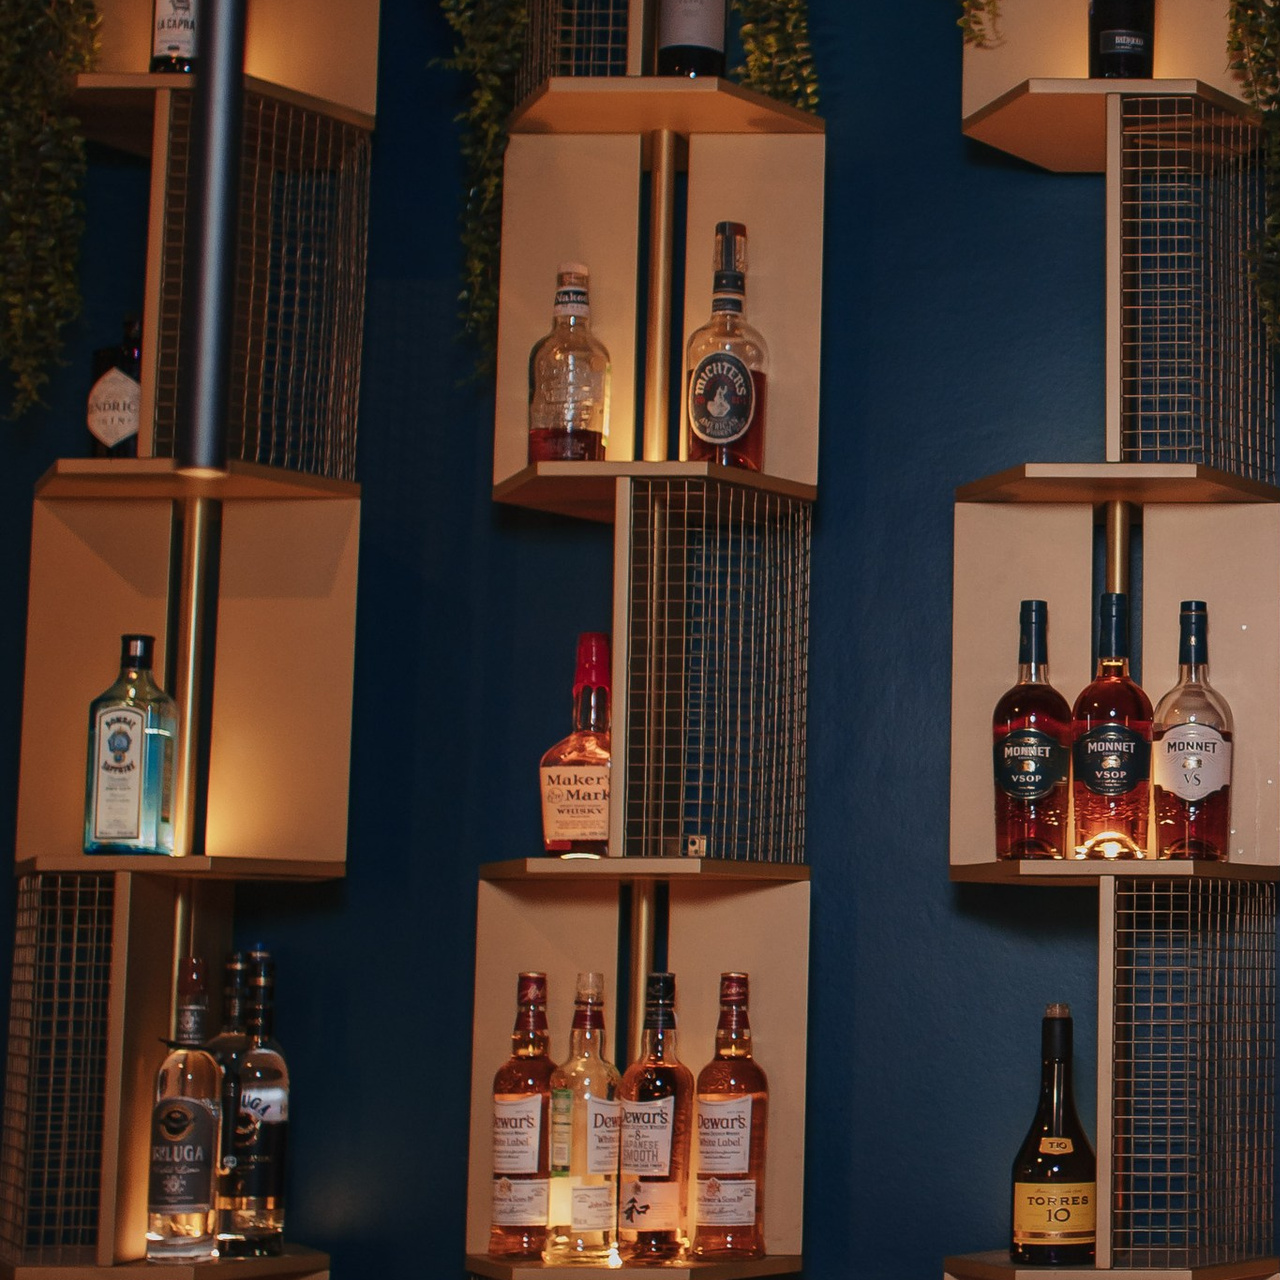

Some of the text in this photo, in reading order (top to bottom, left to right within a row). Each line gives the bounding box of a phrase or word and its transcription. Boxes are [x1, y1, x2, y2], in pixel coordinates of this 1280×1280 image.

[695, 361, 747, 396] MICHTER'S
[1005, 746, 1051, 758] MONNET
[1088, 741, 1136, 754] MONNET
[1168, 742, 1218, 754] MONNET
[1011, 775, 1042, 783] VSOP
[1095, 771, 1127, 779] VSOP
[698, 1114, 747, 1129] Dewar's
[717, 1137, 741, 1147] Label
[623, 1150, 659, 1163] SMOOTH
[1027, 1196, 1089, 1206] TORRES
[624, 1197, 650, 1223] 和
[1047, 1208, 1070, 1222] 10
